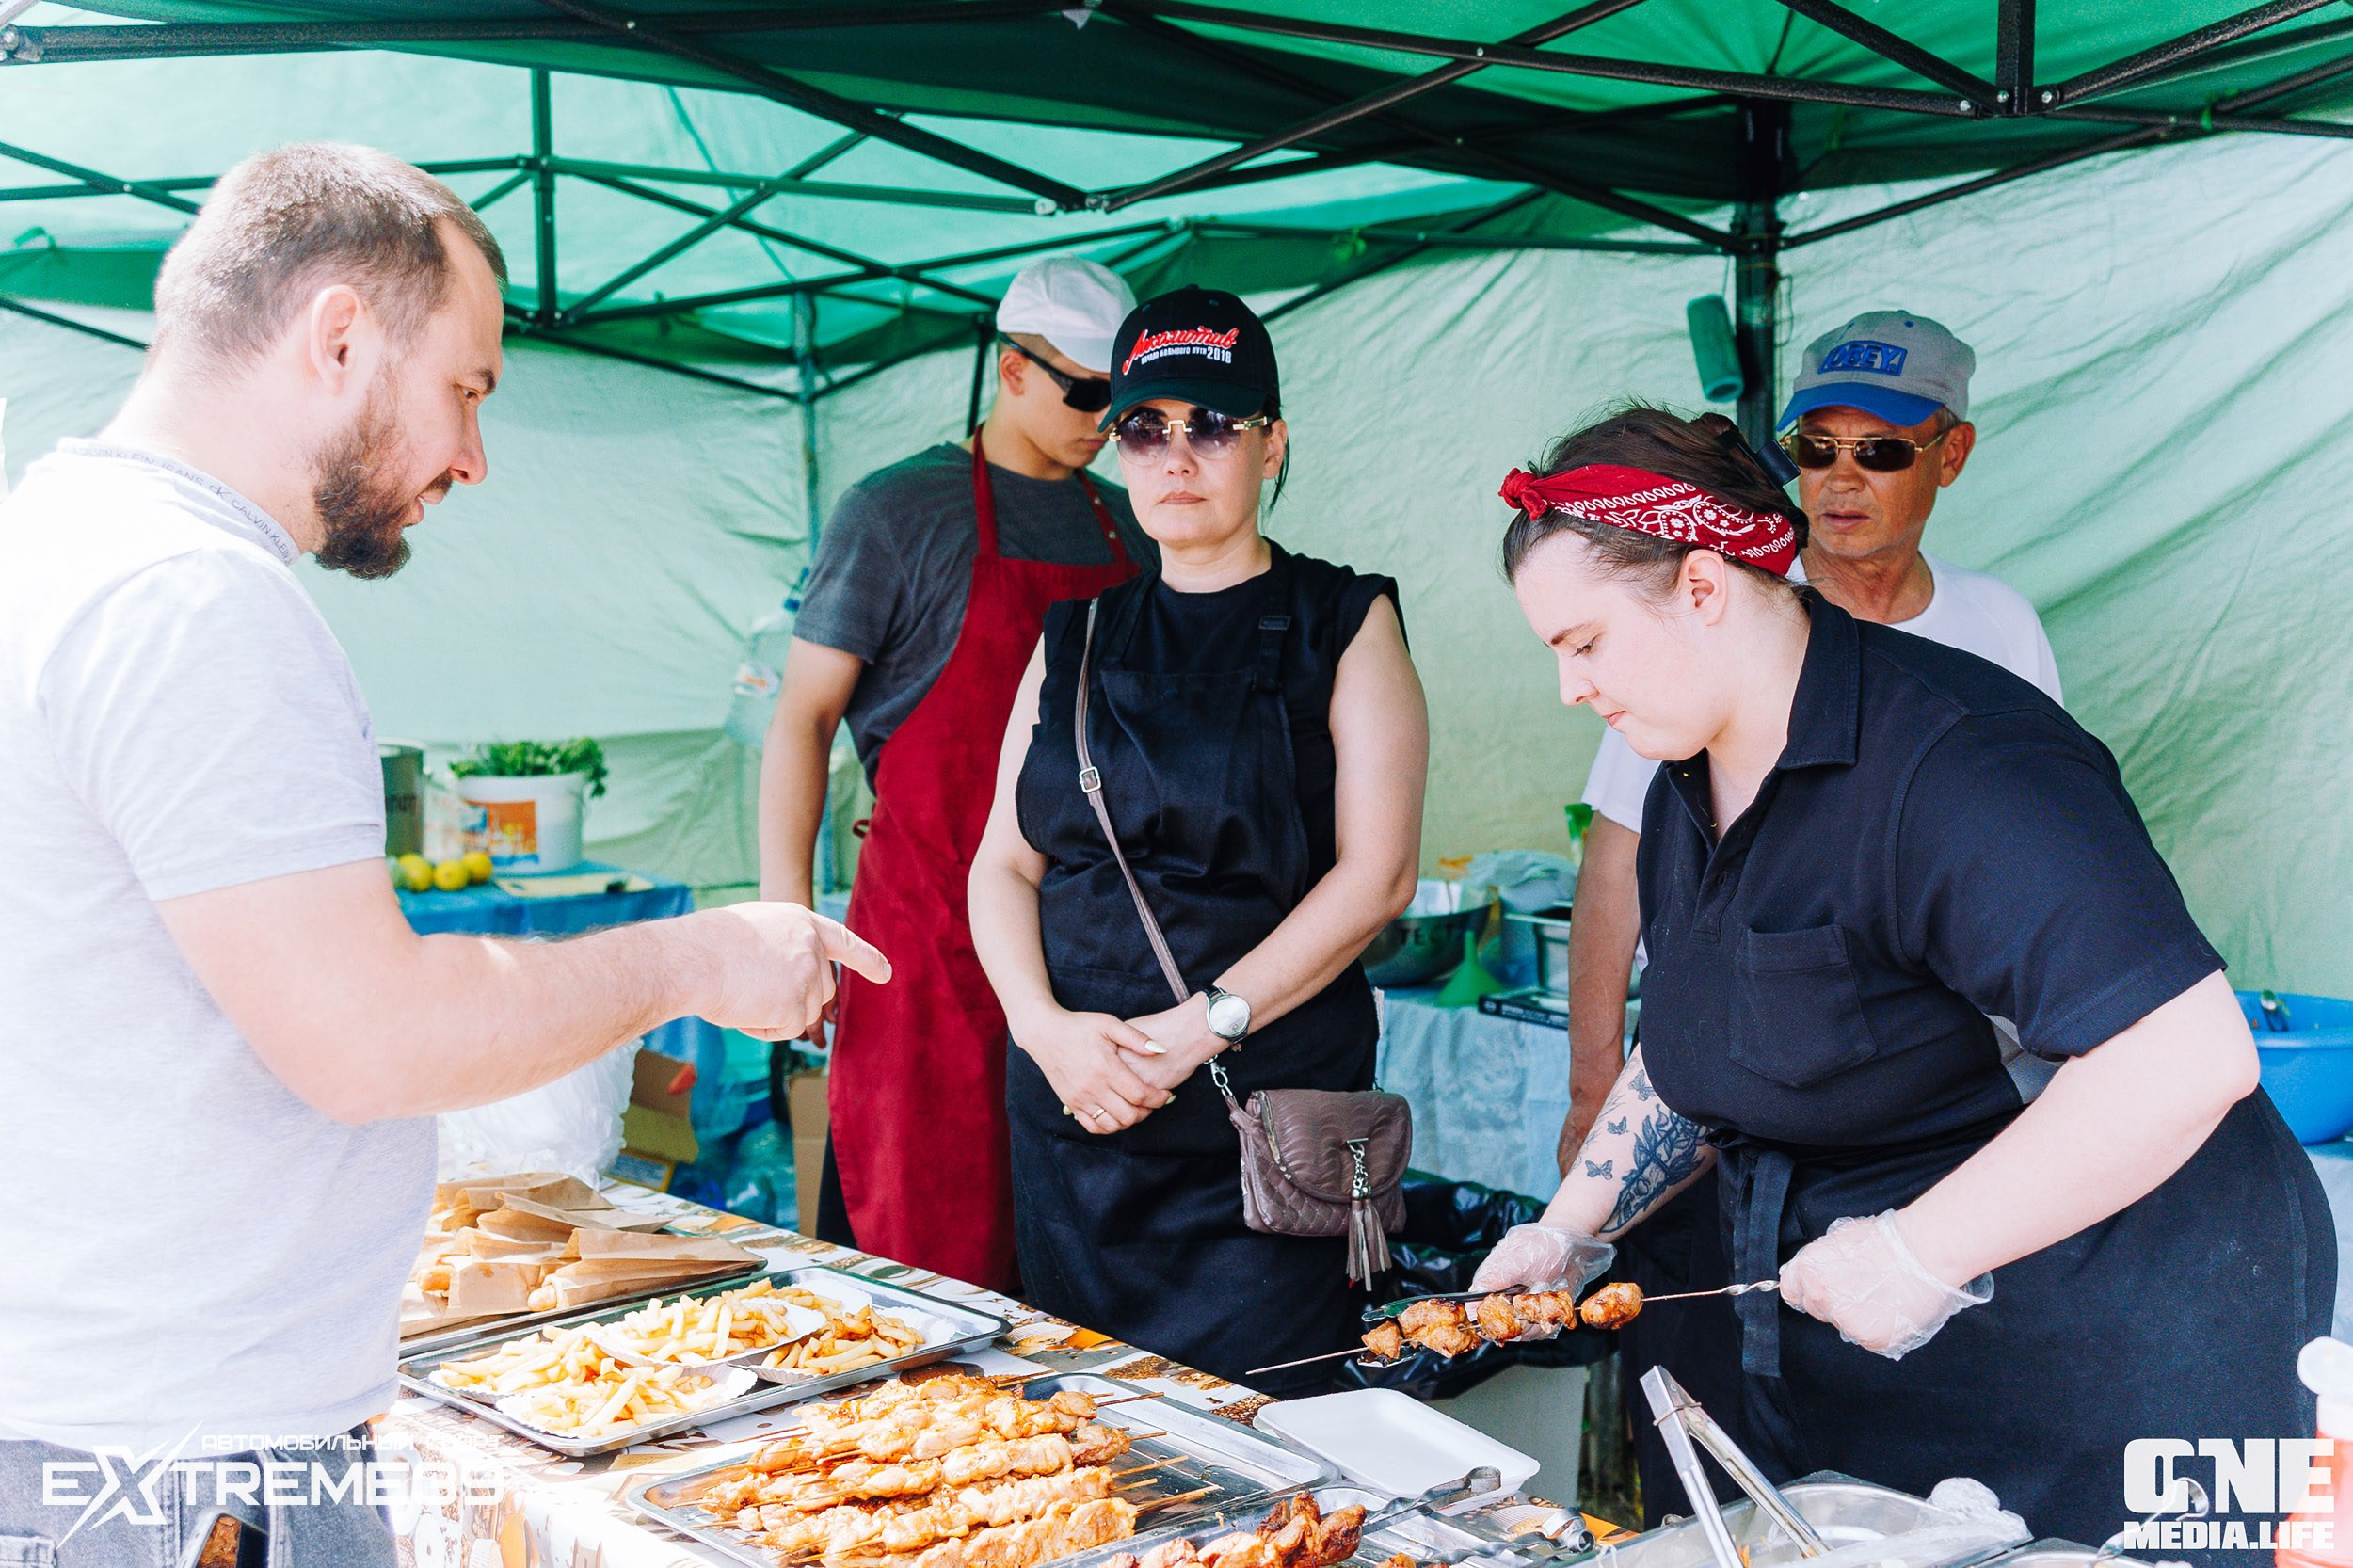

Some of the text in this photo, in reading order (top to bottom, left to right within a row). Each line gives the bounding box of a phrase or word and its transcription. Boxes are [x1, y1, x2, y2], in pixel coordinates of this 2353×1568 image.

[1207, 346, 1232, 364] 2018
[1826, 343, 1899, 370] OBEY
[231, 499, 272, 536] CALVIN
[270, 534, 290, 559] KLEIN
